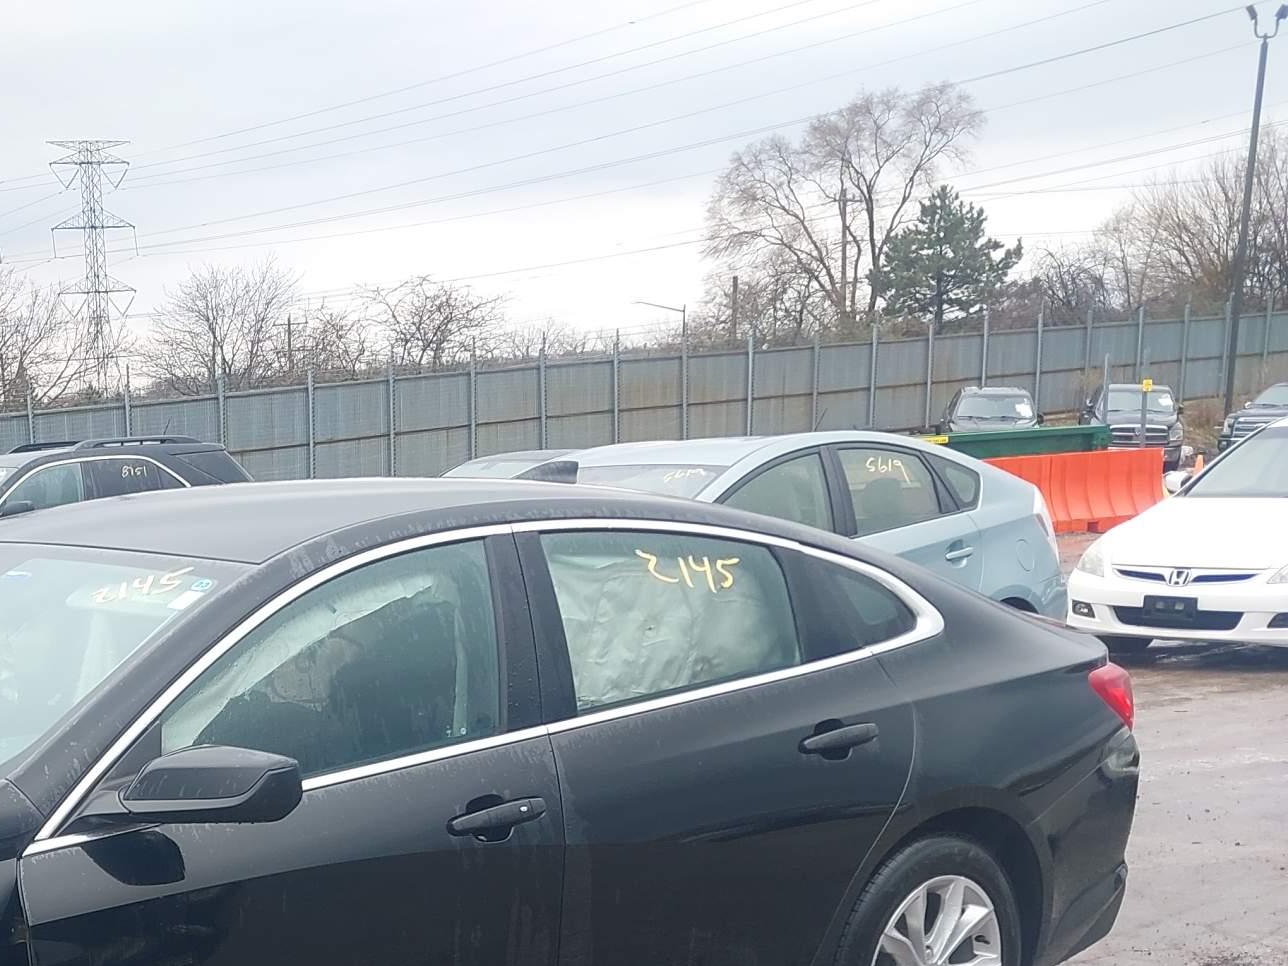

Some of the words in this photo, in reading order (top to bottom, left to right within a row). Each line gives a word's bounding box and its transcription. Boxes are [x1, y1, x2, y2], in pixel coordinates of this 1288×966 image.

[865, 455, 911, 485] 5619
[90, 566, 195, 603] 2145
[634, 549, 740, 593] 2145
